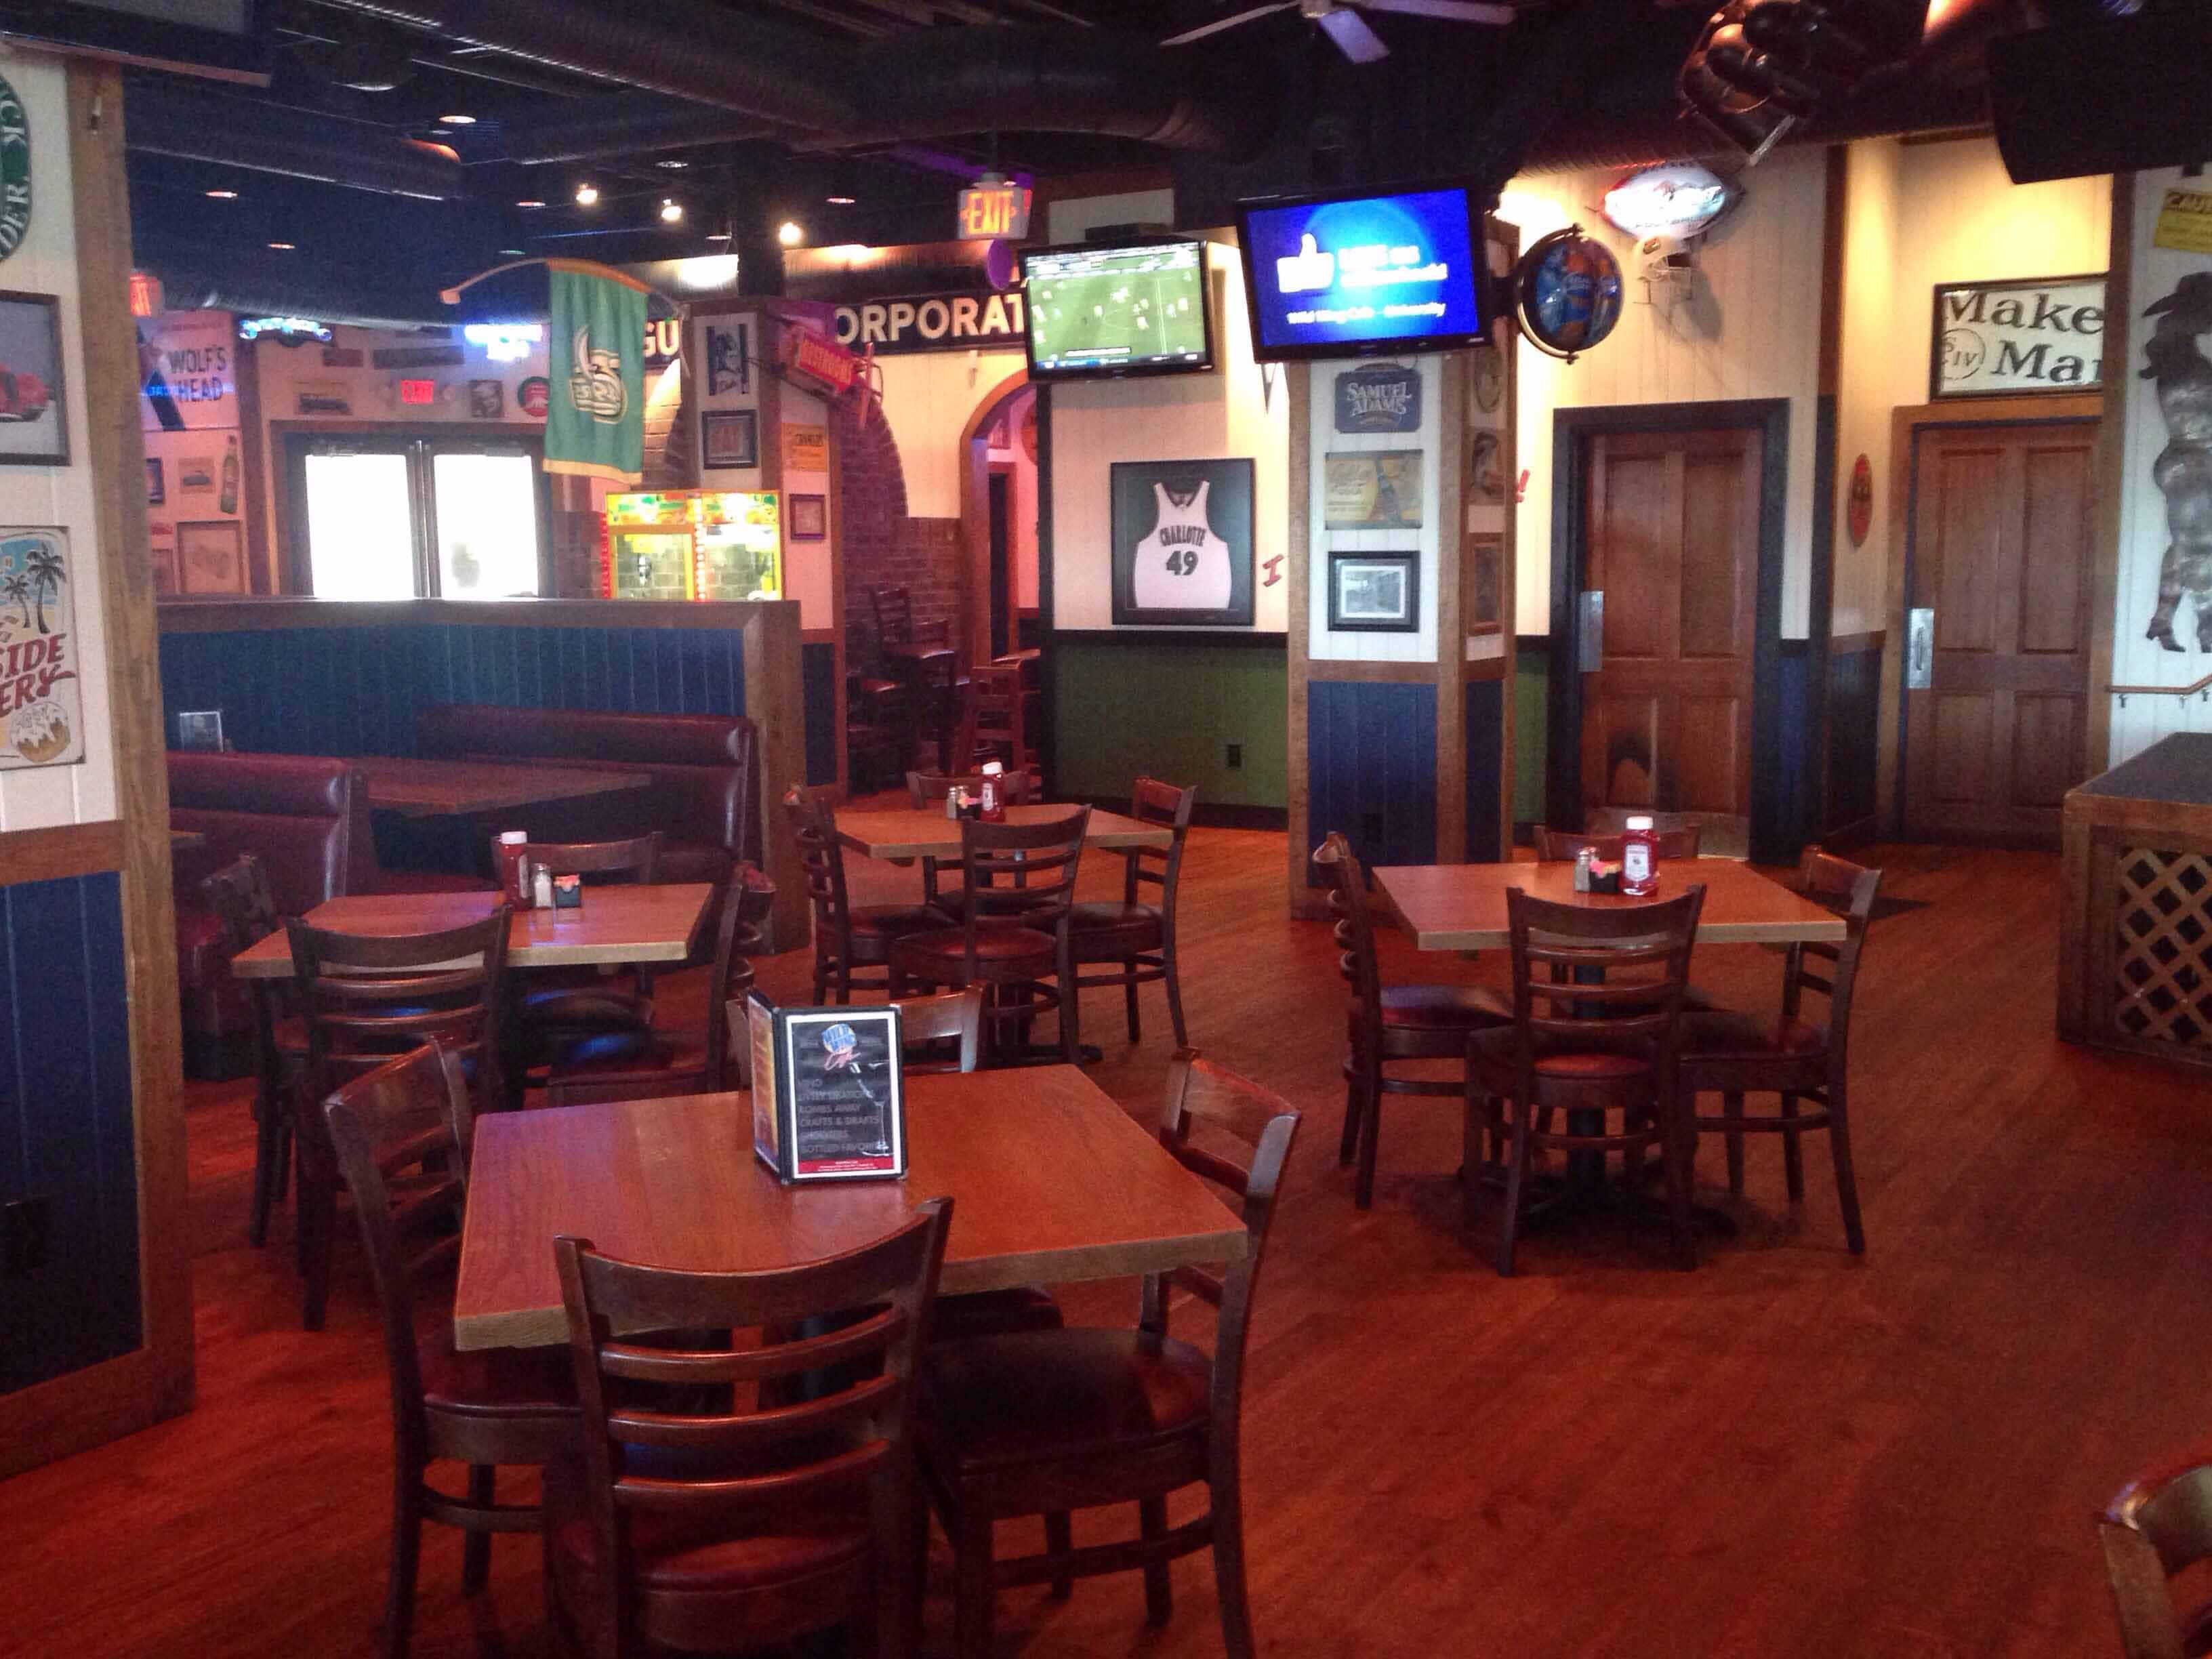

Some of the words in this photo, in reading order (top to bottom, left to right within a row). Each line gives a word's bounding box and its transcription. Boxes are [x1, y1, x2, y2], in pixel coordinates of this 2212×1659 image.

[967, 190, 1014, 234] EXIT
[834, 293, 1024, 344] ORPORAT
[1942, 292, 2104, 335] Make
[642, 319, 680, 358] GU
[169, 344, 228, 373] WOLF'S
[175, 376, 224, 402] HEAD
[1345, 382, 1412, 401] SAMUEL
[1349, 397, 1407, 417] ADAMS
[1160, 525, 1206, 546] CHARLOTTE
[1166, 550, 1199, 576] 49
[0, 663, 77, 718] ERY
